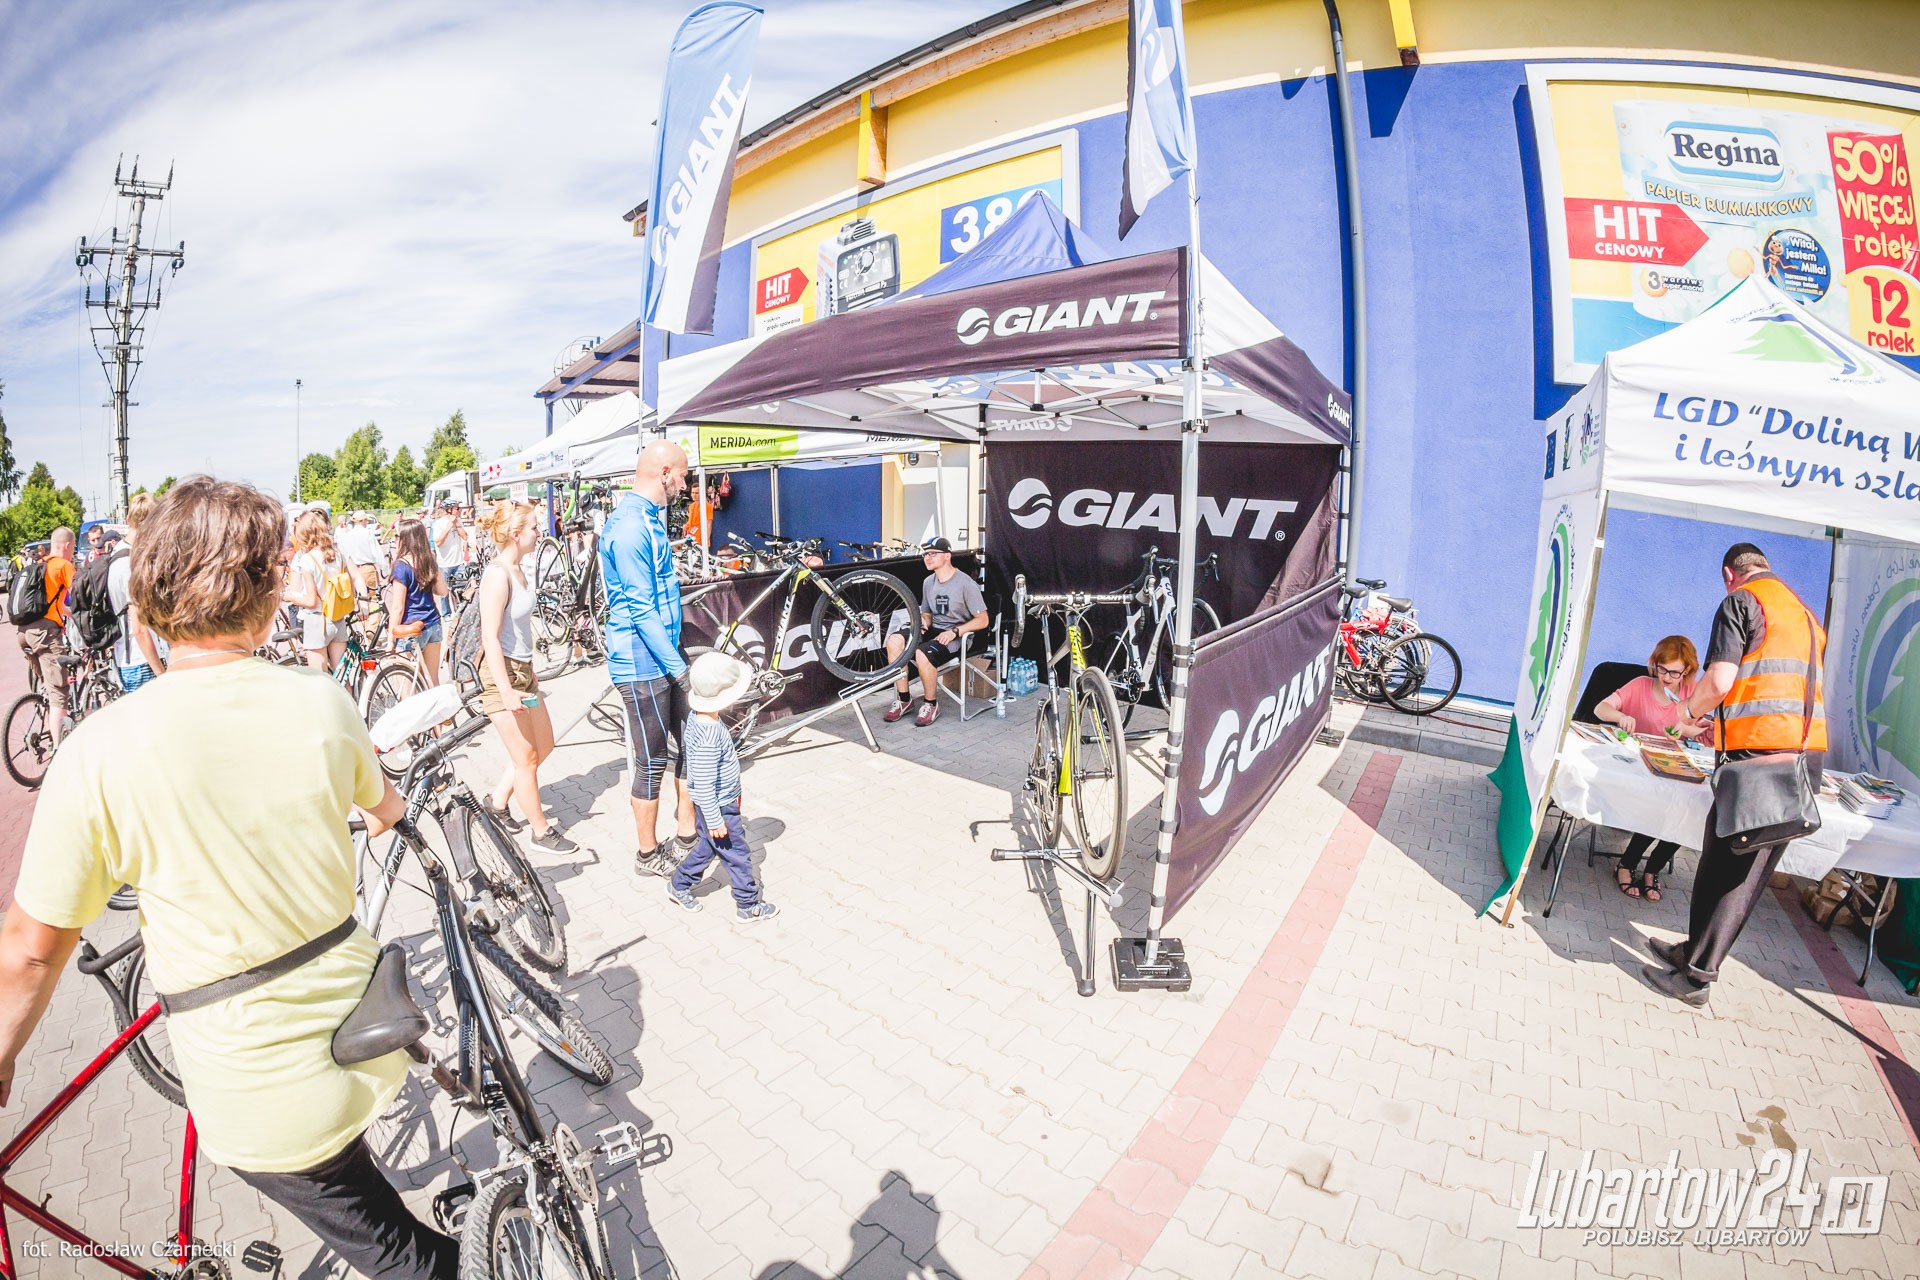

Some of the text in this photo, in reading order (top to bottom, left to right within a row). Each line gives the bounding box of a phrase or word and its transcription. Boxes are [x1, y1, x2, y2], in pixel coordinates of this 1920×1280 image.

[666, 72, 735, 229] GIANT
[1671, 132, 1780, 167] Regina
[1832, 136, 1908, 188] 50%
[1645, 180, 1813, 217] PAPIER RUMIANKOWY
[1837, 188, 1915, 231] WIĘCEJ
[950, 188, 1050, 254] 38
[1593, 204, 1662, 242] HIT
[1594, 242, 1665, 259] CENOWY
[1785, 248, 1817, 262] jestem
[1789, 236, 1818, 251] Witaj,
[1854, 231, 1914, 260] rolek
[765, 273, 791, 299] HIT
[1648, 271, 1661, 290] 3
[764, 294, 791, 308] CENOWY
[993, 290, 1166, 337] GIANT
[1863, 275, 1911, 329] 12
[1867, 329, 1915, 353] rolek
[1653, 392, 1740, 427] LGD
[710, 436, 777, 449] MERIDA.com
[1675, 433, 1688, 461] i
[1699, 437, 1845, 488] leśnym
[1058, 488, 1299, 540] GIANT
[1237, 643, 1330, 773] GIANT
